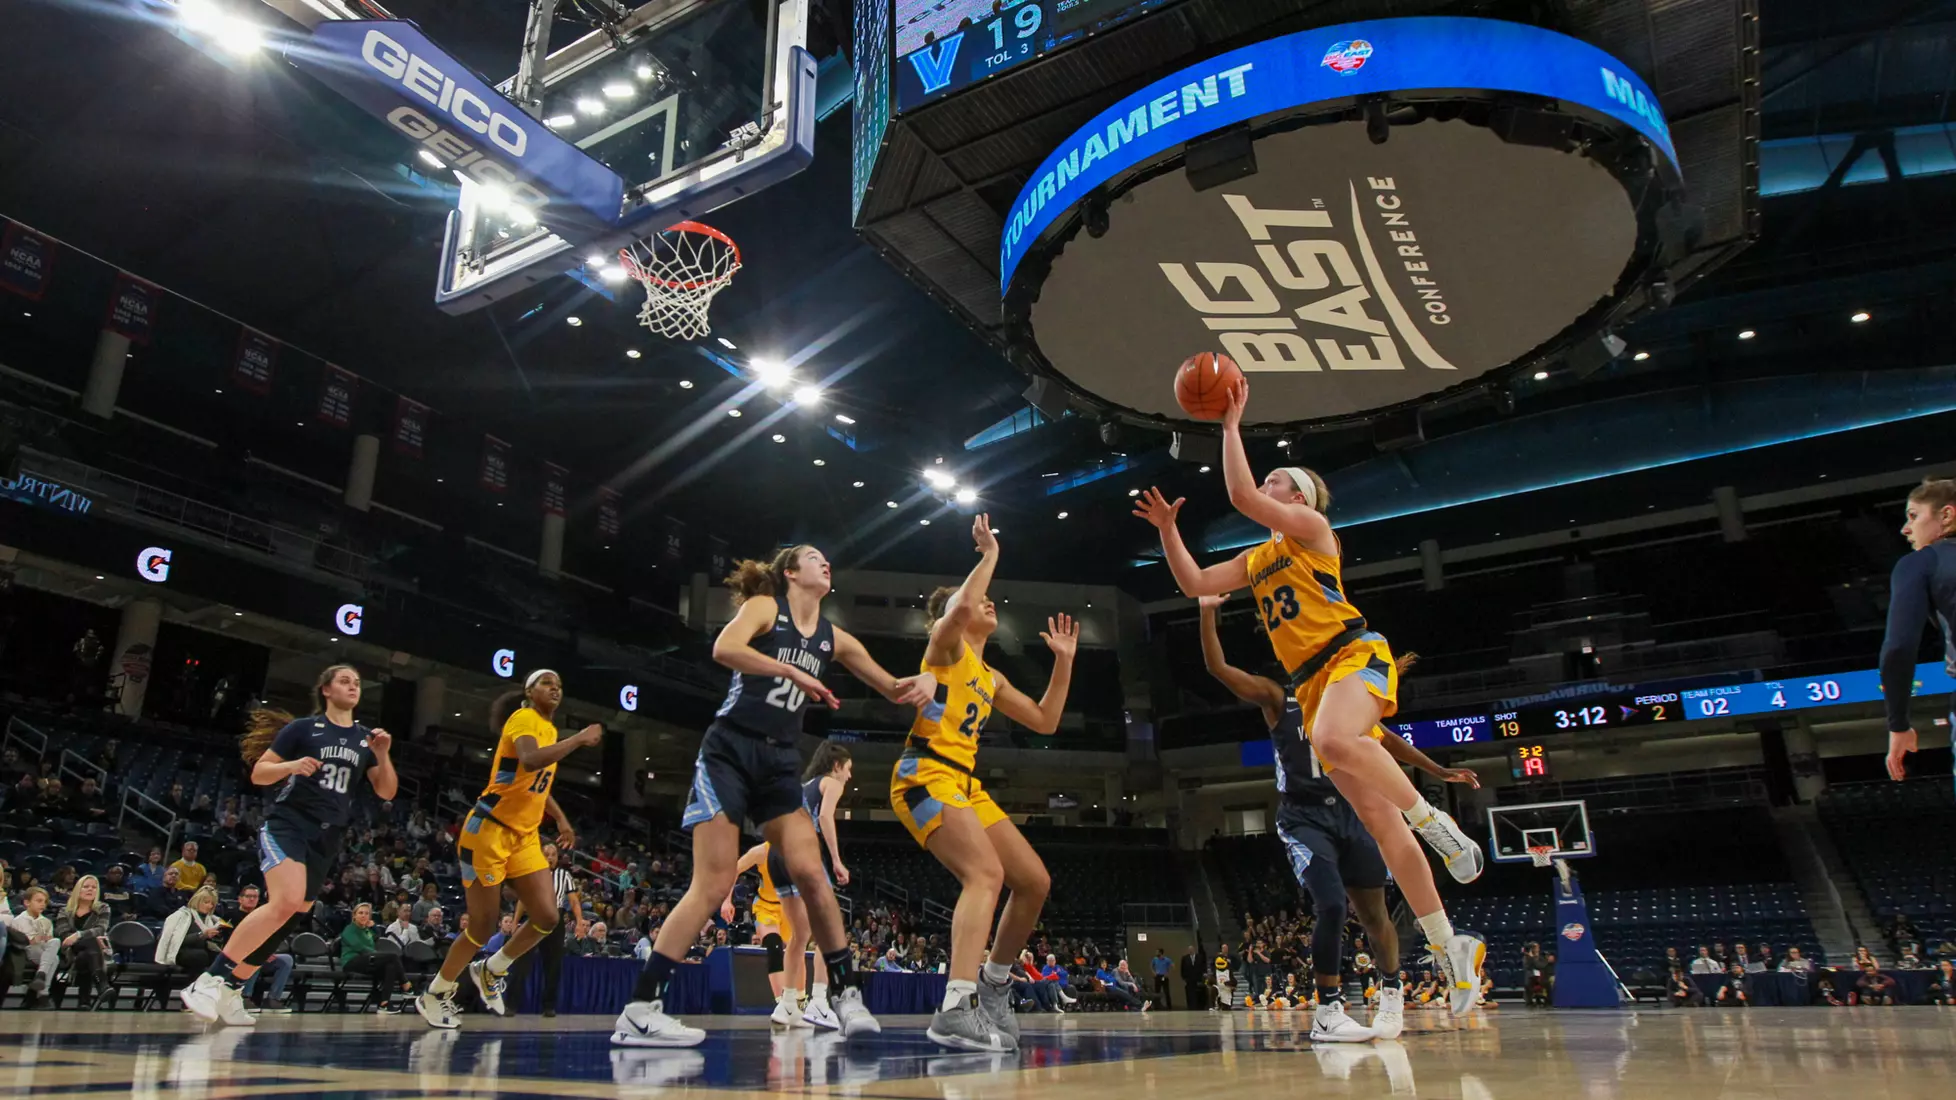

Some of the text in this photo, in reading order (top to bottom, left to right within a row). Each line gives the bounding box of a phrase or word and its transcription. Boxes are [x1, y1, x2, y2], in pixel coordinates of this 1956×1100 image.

[987, 3, 1042, 50] 19
[985, 42, 1029, 68] TOL 3
[362, 29, 527, 157] GEICO
[387, 106, 550, 206] GEICO
[1004, 62, 1254, 261] TOURNAMENT
[1367, 176, 1452, 325] CONFERENCE
[1222, 194, 1405, 370] EAST
[1158, 262, 1323, 372] BIG
[137, 546, 173, 582] G
[336, 603, 363, 635] G
[1261, 584, 1300, 632] 23
[492, 648, 515, 678] G
[776, 647, 821, 678] VILLANOVA
[619, 685, 638, 711] G
[765, 676, 806, 713] 20
[1634, 692, 1678, 706] PERIOD
[1682, 685, 1742, 700] TEAM FOULS
[1770, 691, 1787, 708] 4
[1806, 680, 1841, 702] 30
[1494, 711, 1518, 722] SHOT
[1554, 706, 1608, 729] 3:12
[1652, 705, 1666, 721] 2
[1700, 697, 1729, 716] 02
[1435, 715, 1486, 728] TEAM FOULS
[1451, 725, 1474, 743] 02
[1499, 721, 1520, 737] 19
[1402, 732, 1414, 746] 3
[320, 745, 360, 767] VILLANOVA
[1524, 757, 1544, 776] 19
[319, 763, 351, 794] 30
